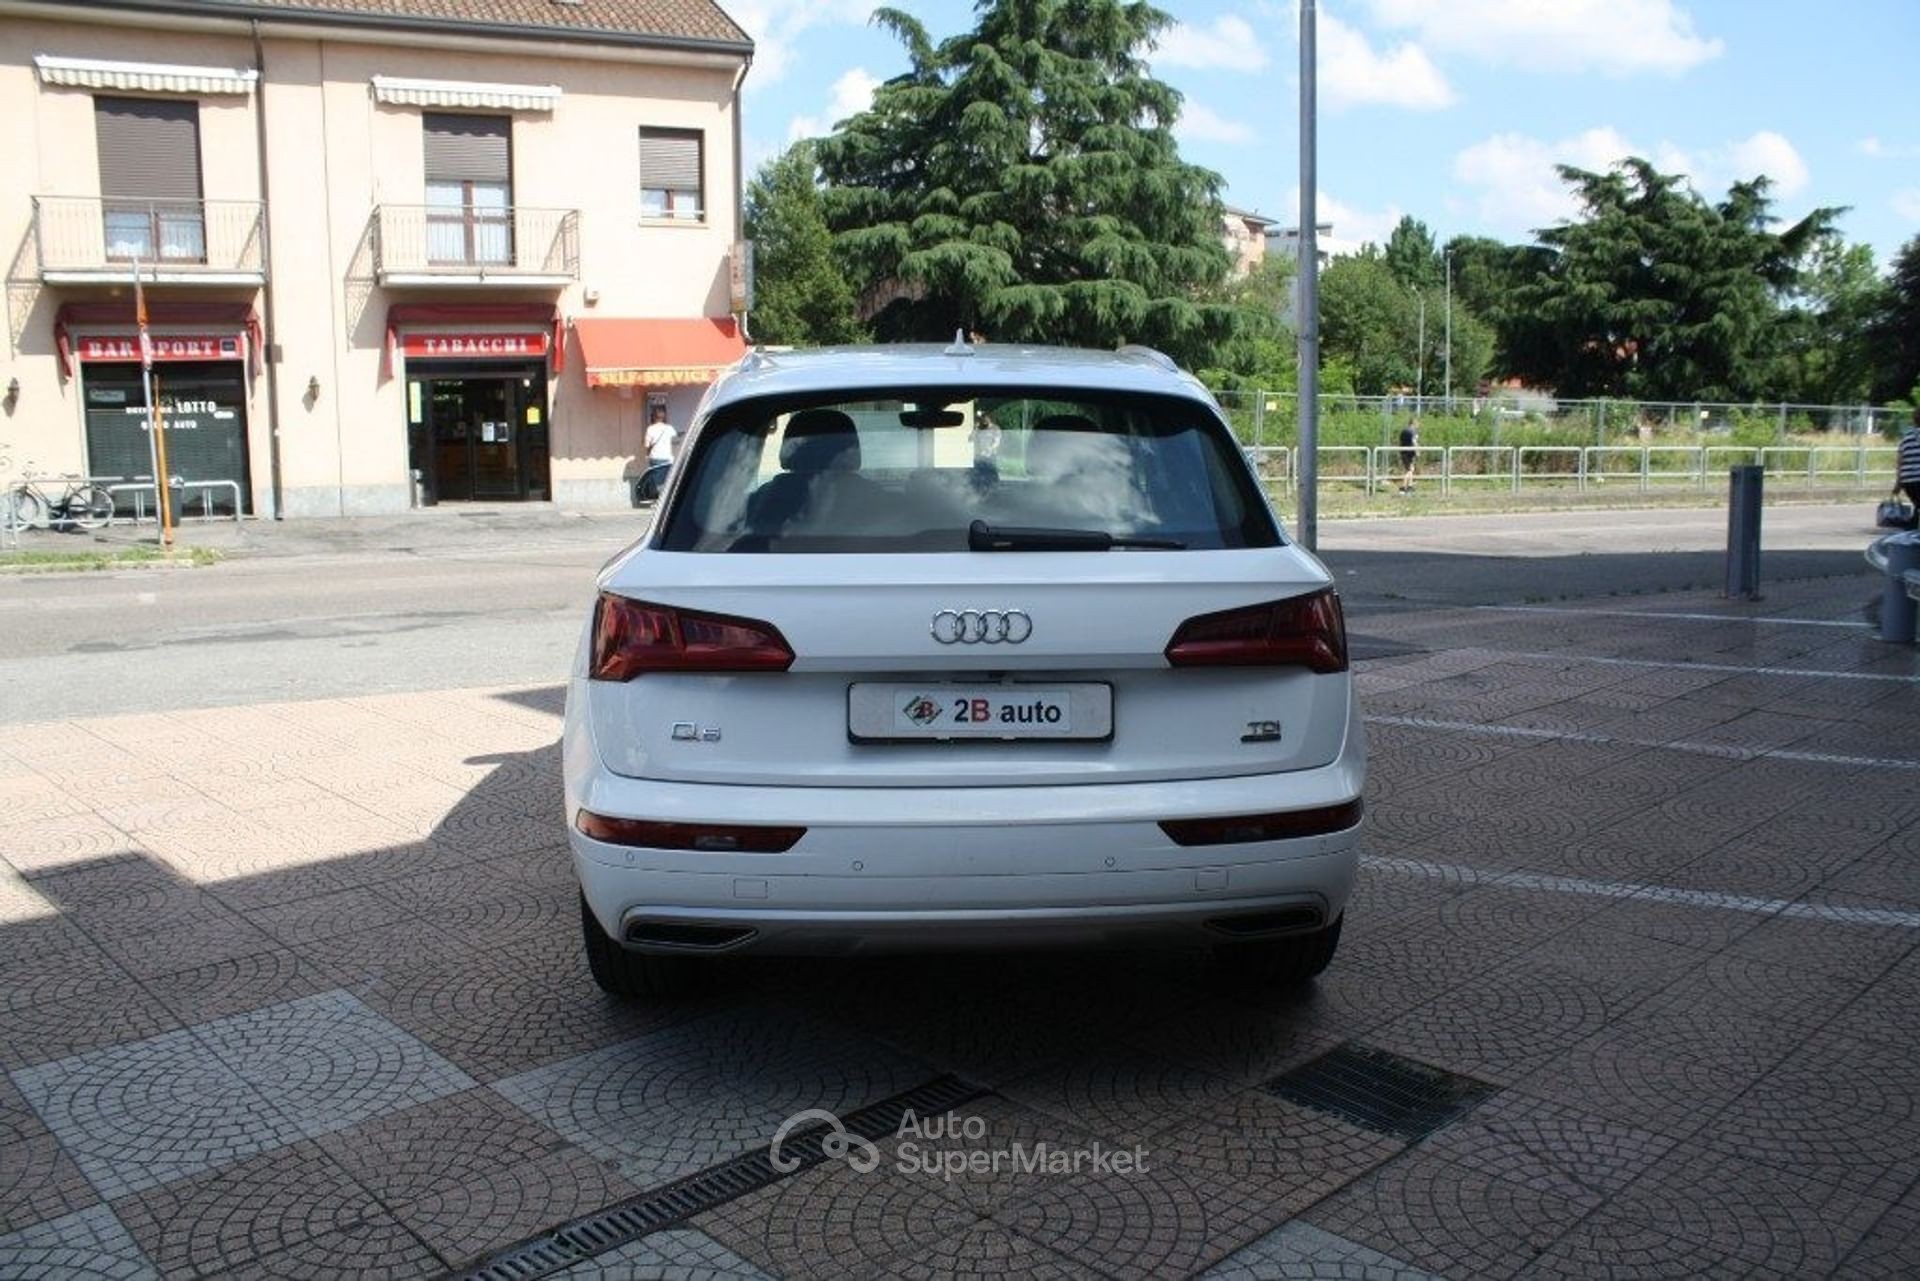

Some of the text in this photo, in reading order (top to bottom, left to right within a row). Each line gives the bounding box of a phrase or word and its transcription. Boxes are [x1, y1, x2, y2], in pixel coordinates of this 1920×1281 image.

[88, 341, 134, 357] BAR
[424, 338, 528, 353] TABACCHI
[176, 401, 217, 414] LOTTO
[954, 699, 1062, 723] 2B auto
[1247, 720, 1281, 737] TDI
